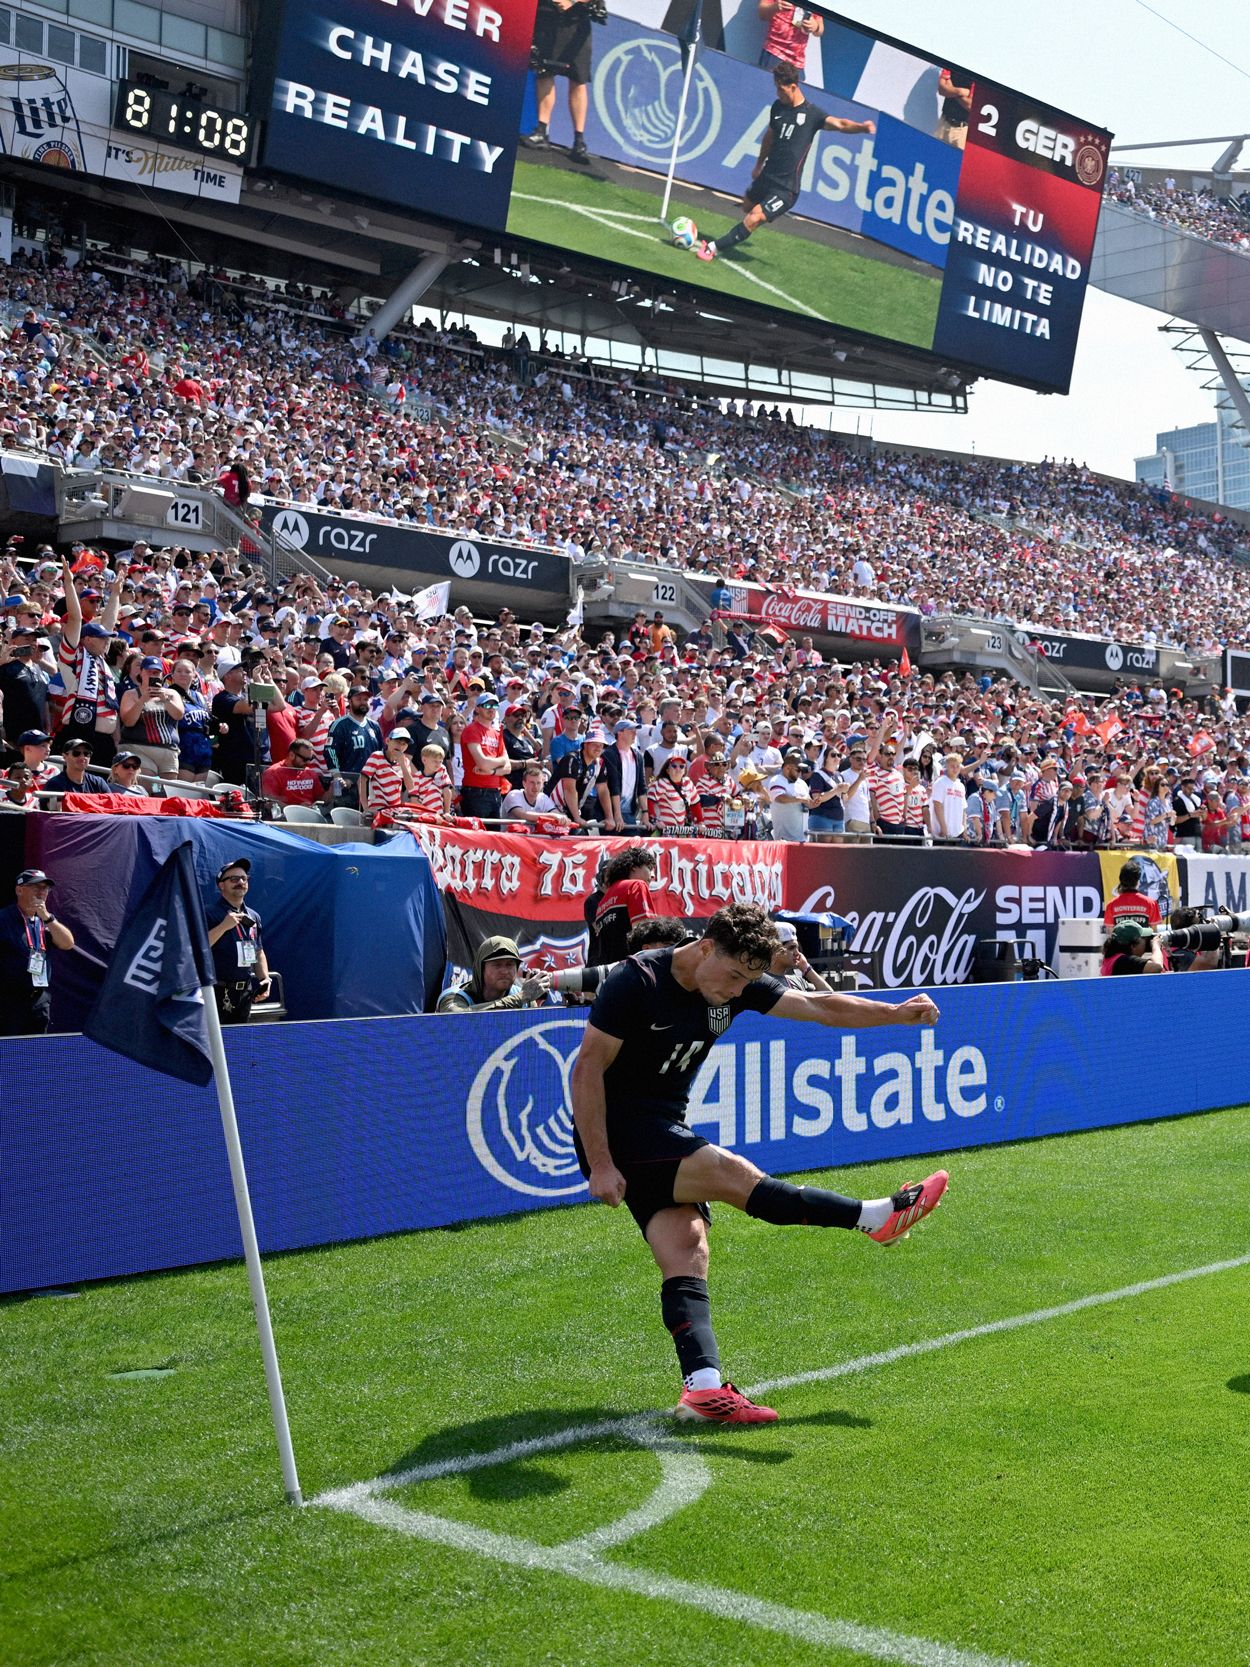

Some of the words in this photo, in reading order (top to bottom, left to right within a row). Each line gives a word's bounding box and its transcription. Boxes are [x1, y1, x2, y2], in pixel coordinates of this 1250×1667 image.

[379, 0, 503, 43] VER
[328, 26, 492, 106] CHASE
[8, 96, 71, 139] Lite
[125, 88, 249, 157] 81:08
[284, 81, 504, 174] REALITY
[779, 124, 795, 140] 14
[977, 104, 999, 137] 2
[1015, 118, 1076, 167] GER
[107, 146, 134, 164] IT'S
[130, 149, 205, 176] Miller
[193, 169, 226, 188] TIME
[1124, 169, 1142, 183] 427
[1011, 203, 1044, 233] TU
[957, 220, 1082, 281] REALIDAD
[977, 263, 1014, 293] NO
[1023, 276, 1054, 306] TE
[967, 295, 1051, 340] LIMITA
[170, 502, 201, 525] 121
[319, 525, 378, 553] razr
[488, 554, 539, 580] razr
[654, 583, 676, 601] 122
[827, 602, 897, 624] SEND-OFF
[827, 616, 897, 639] MATCH
[1041, 640, 1068, 658] azr
[1127, 651, 1156, 669] razr
[351, 736, 365, 749] 10
[420, 824, 521, 896] Barra
[539, 850, 588, 896] 76
[709, 1007, 731, 1021] USA
[685, 1029, 988, 1147] Allstate
